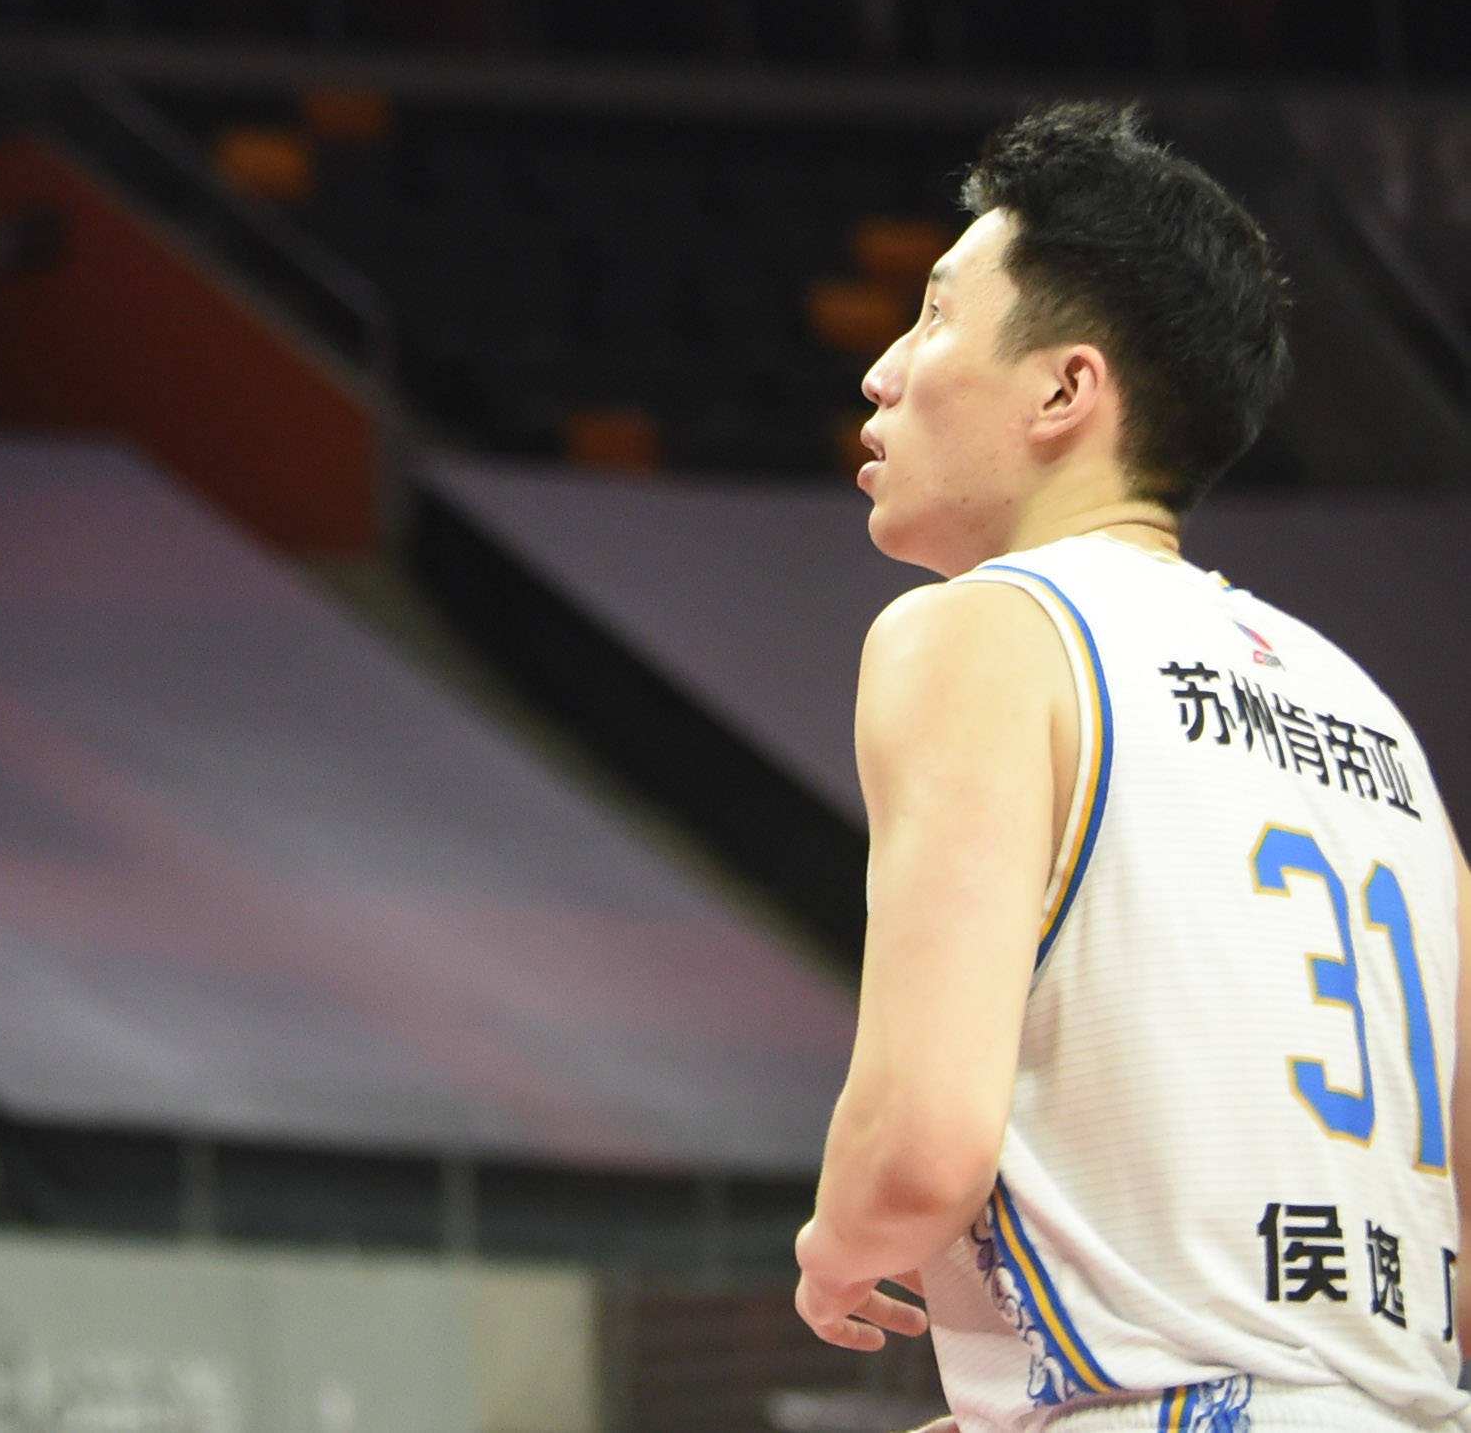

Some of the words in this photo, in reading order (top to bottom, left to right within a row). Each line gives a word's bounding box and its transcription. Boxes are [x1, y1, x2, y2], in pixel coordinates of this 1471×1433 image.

[1158, 661, 1422, 821] 苏州肯帝亚
[1248, 820, 1448, 1176] 31
